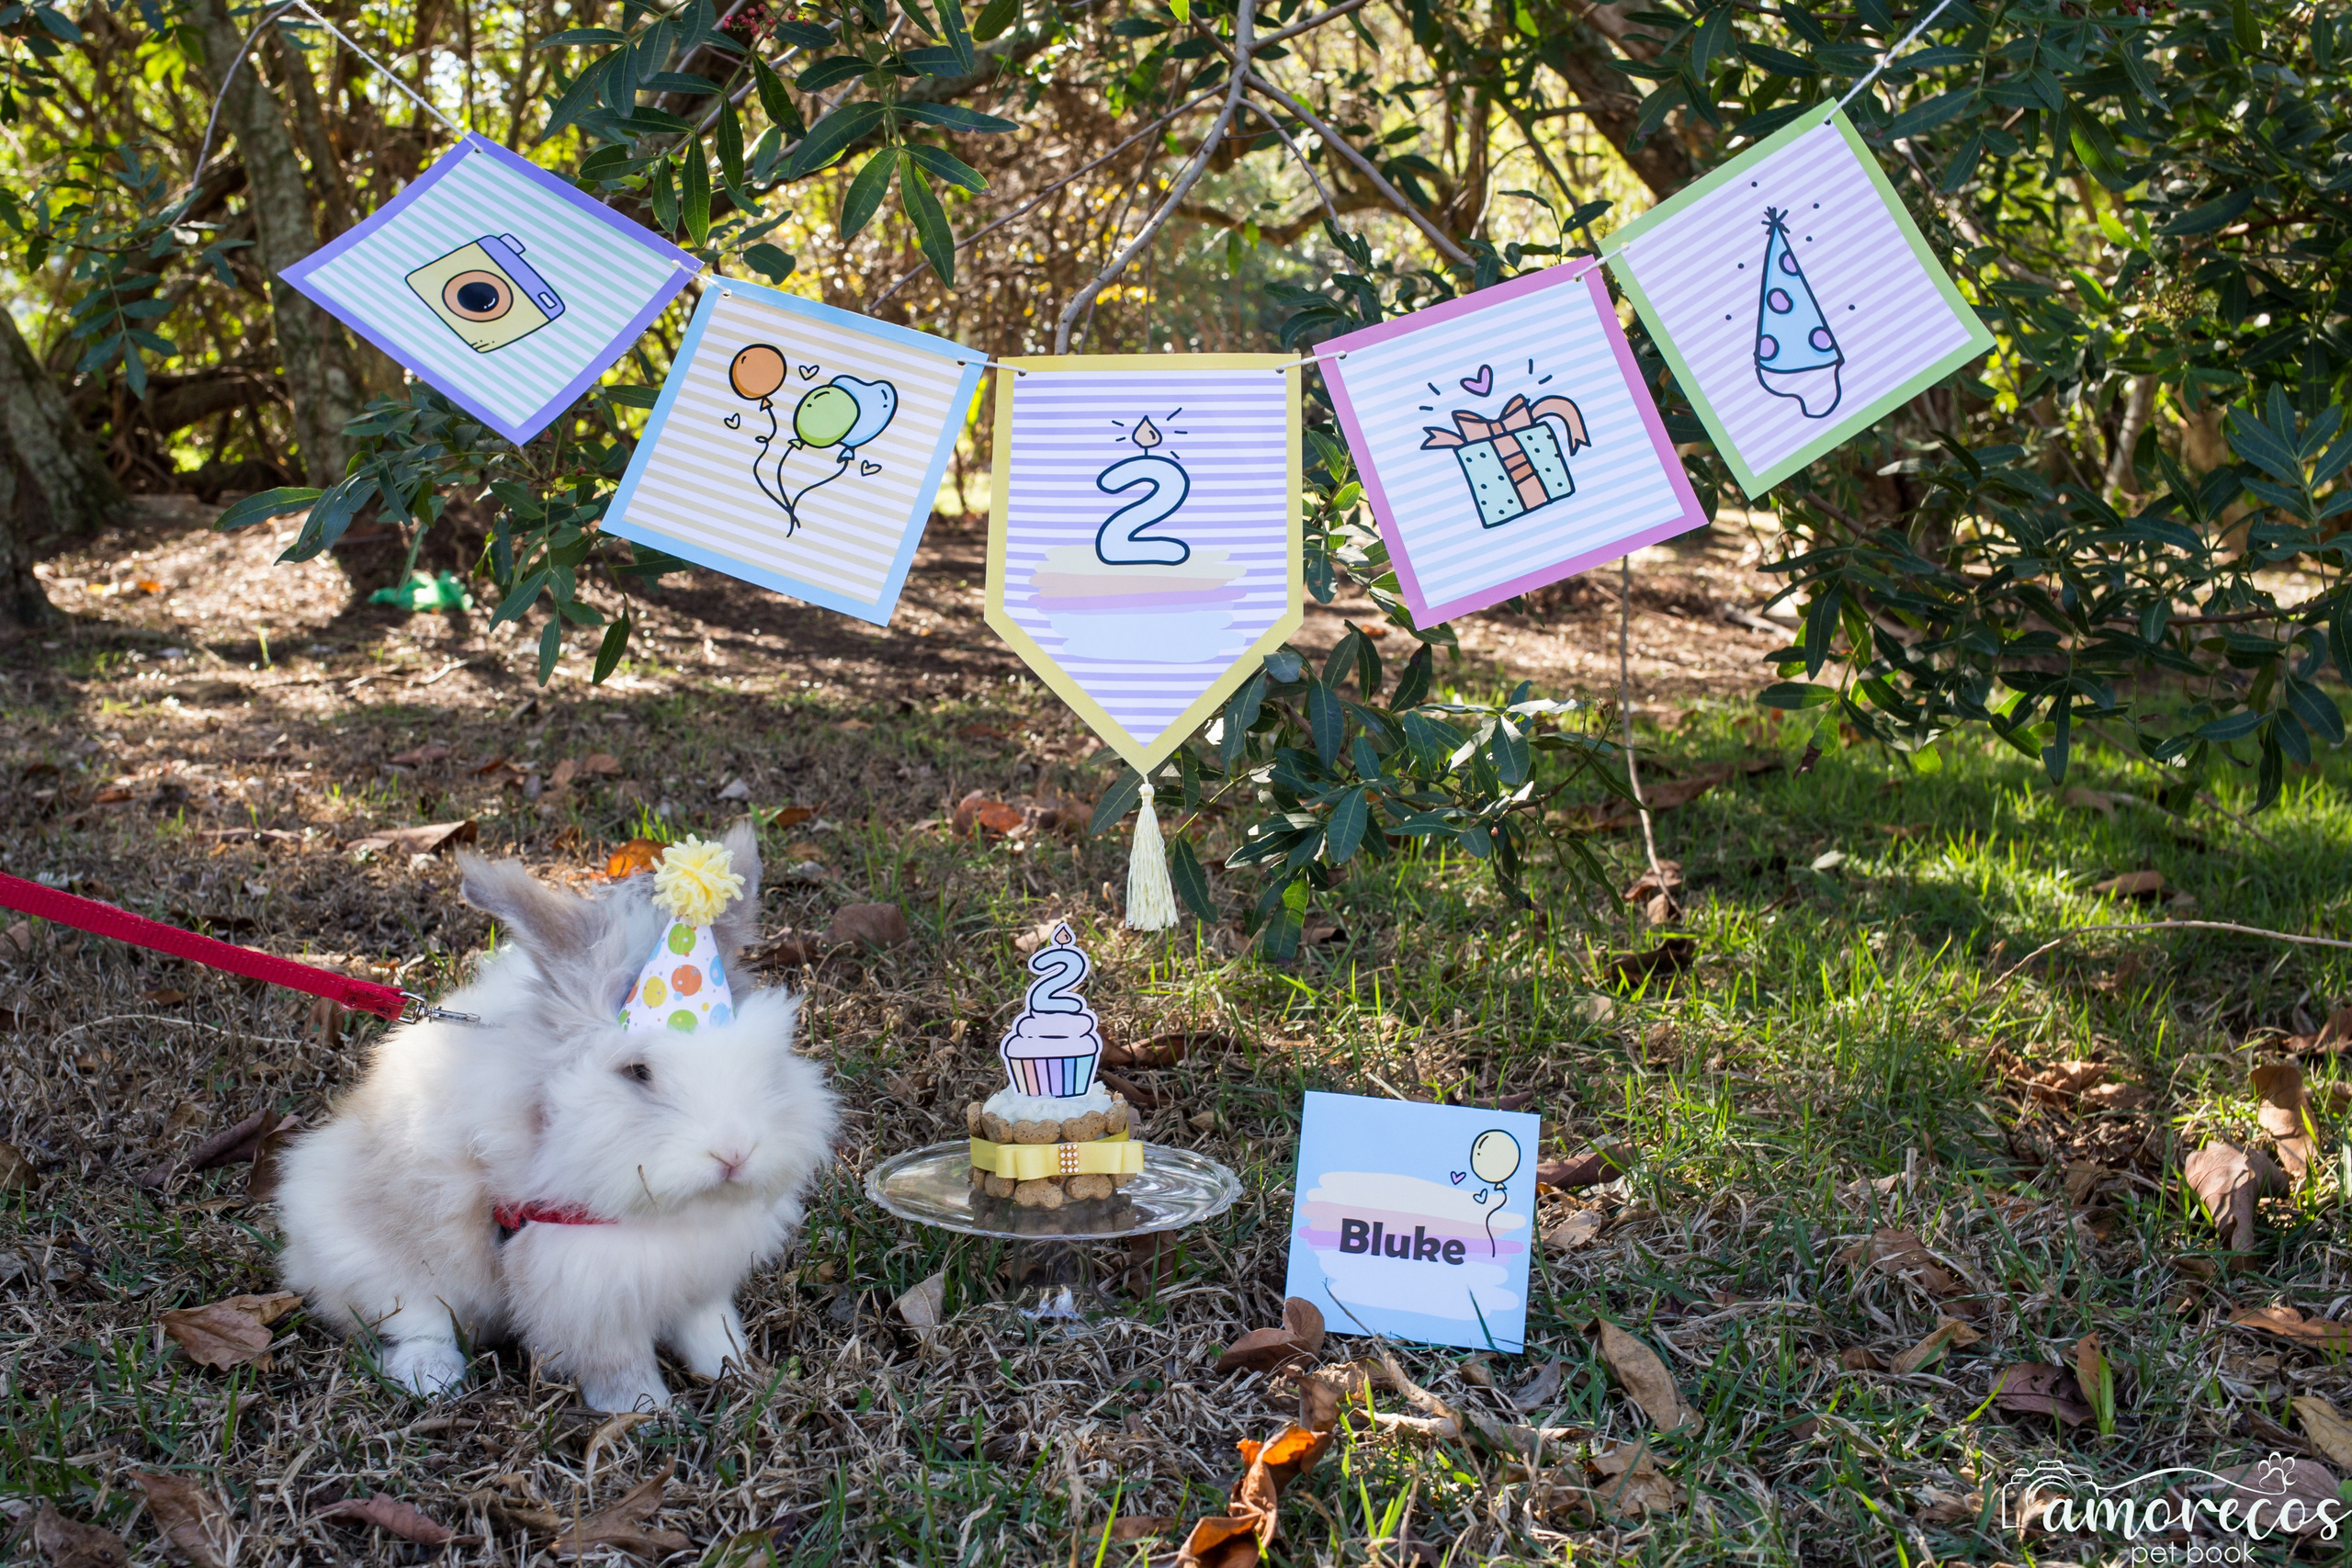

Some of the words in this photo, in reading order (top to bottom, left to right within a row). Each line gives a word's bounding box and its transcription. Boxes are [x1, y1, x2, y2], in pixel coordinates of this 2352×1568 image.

[1095, 455, 1191, 566] 2
[1030, 949, 1086, 1014] 2
[1339, 1218, 1466, 1266] Bluke
